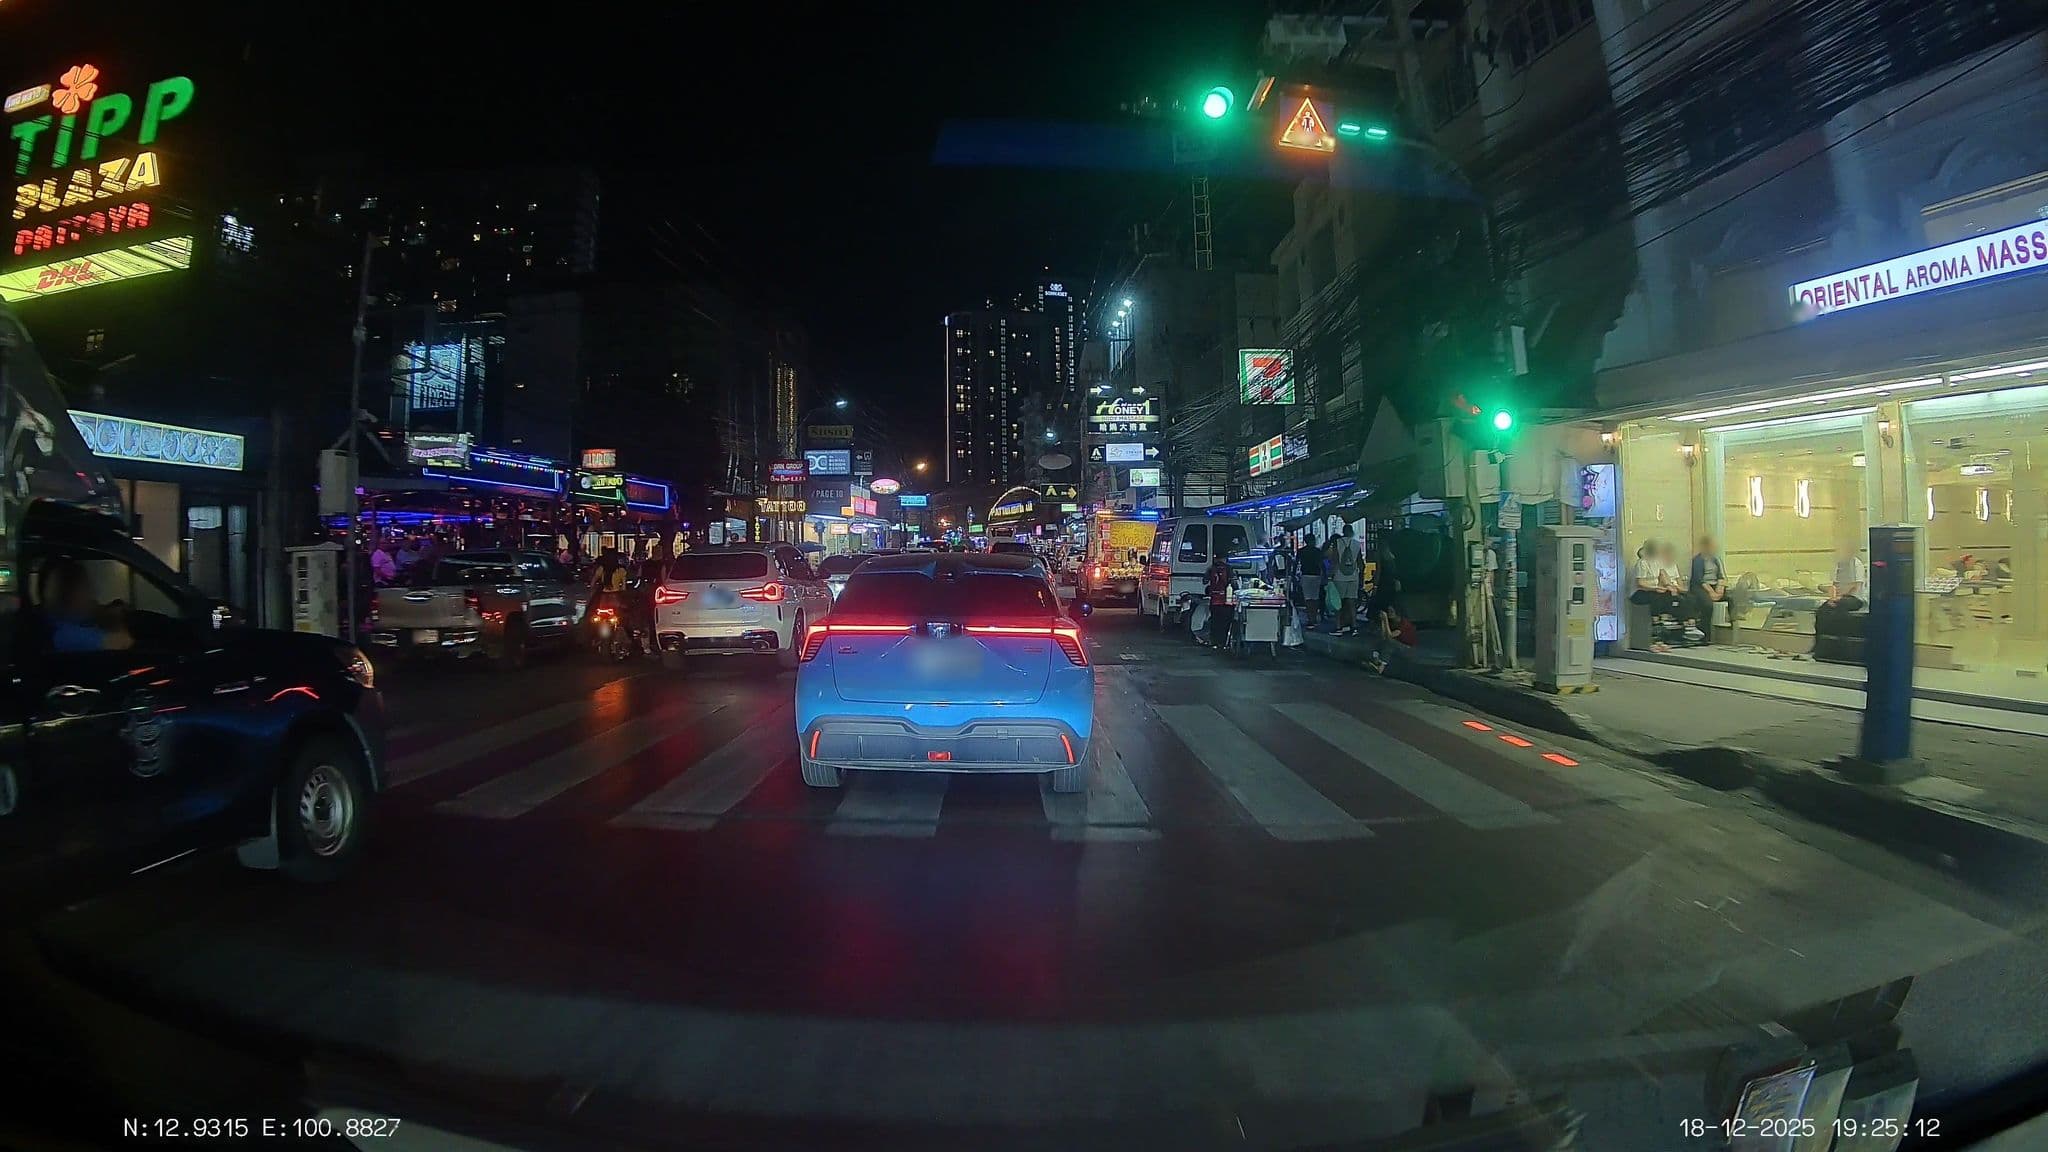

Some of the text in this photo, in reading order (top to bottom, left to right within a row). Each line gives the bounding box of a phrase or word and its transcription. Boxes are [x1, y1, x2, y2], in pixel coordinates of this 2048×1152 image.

[10, 76, 194, 176] TIPP
[12, 151, 160, 220] PLAZA
[14, 202, 151, 255] PATTAYA
[37, 260, 92, 290] DHL
[1800, 231, 2047, 307] ORIENTAL AROMA MASS
[758, 500, 806, 512] TATTOO
[815, 490, 834, 498] PAGE
